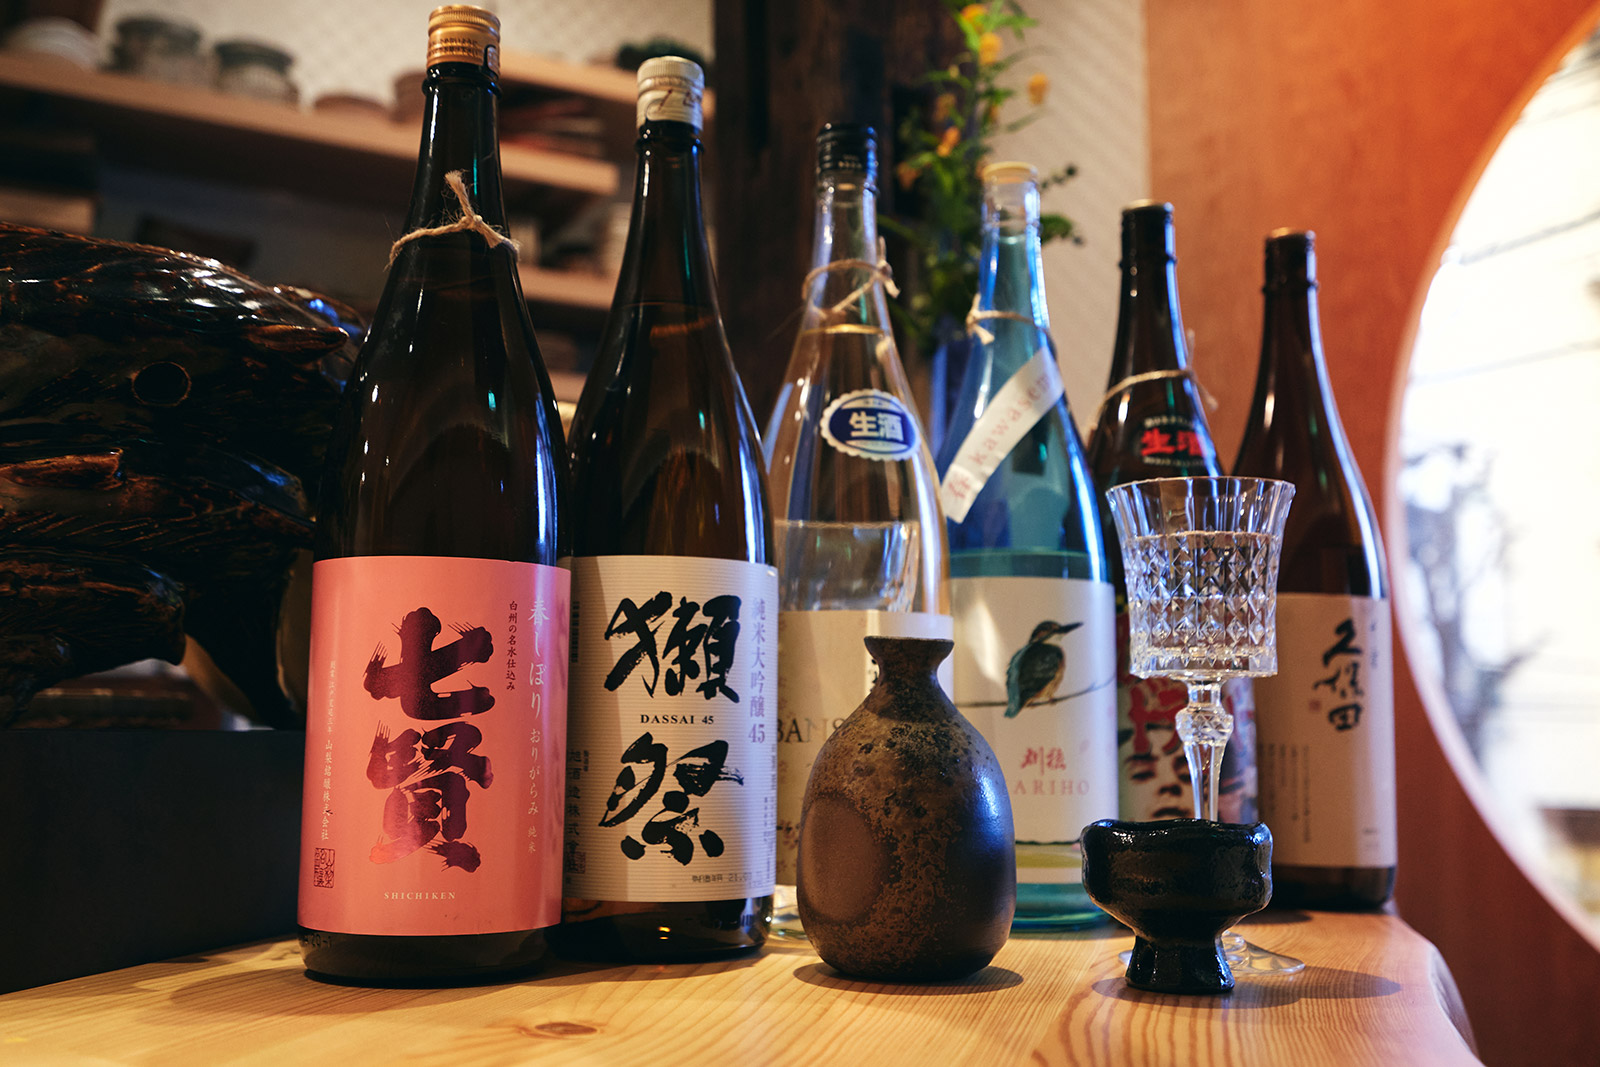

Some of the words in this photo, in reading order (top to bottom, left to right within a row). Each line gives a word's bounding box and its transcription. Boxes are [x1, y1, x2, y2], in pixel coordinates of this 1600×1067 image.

[849, 411, 904, 442] 生酒
[506, 600, 518, 692] 白州の名水仕込み
[528, 597, 550, 720] 春しぼり
[640, 714, 695, 725] DASSAI
[702, 714, 714, 725] 45
[748, 723, 766, 744] 45
[527, 728, 542, 816] おりがらみ
[383, 891, 457, 900] SHICHIKEN
